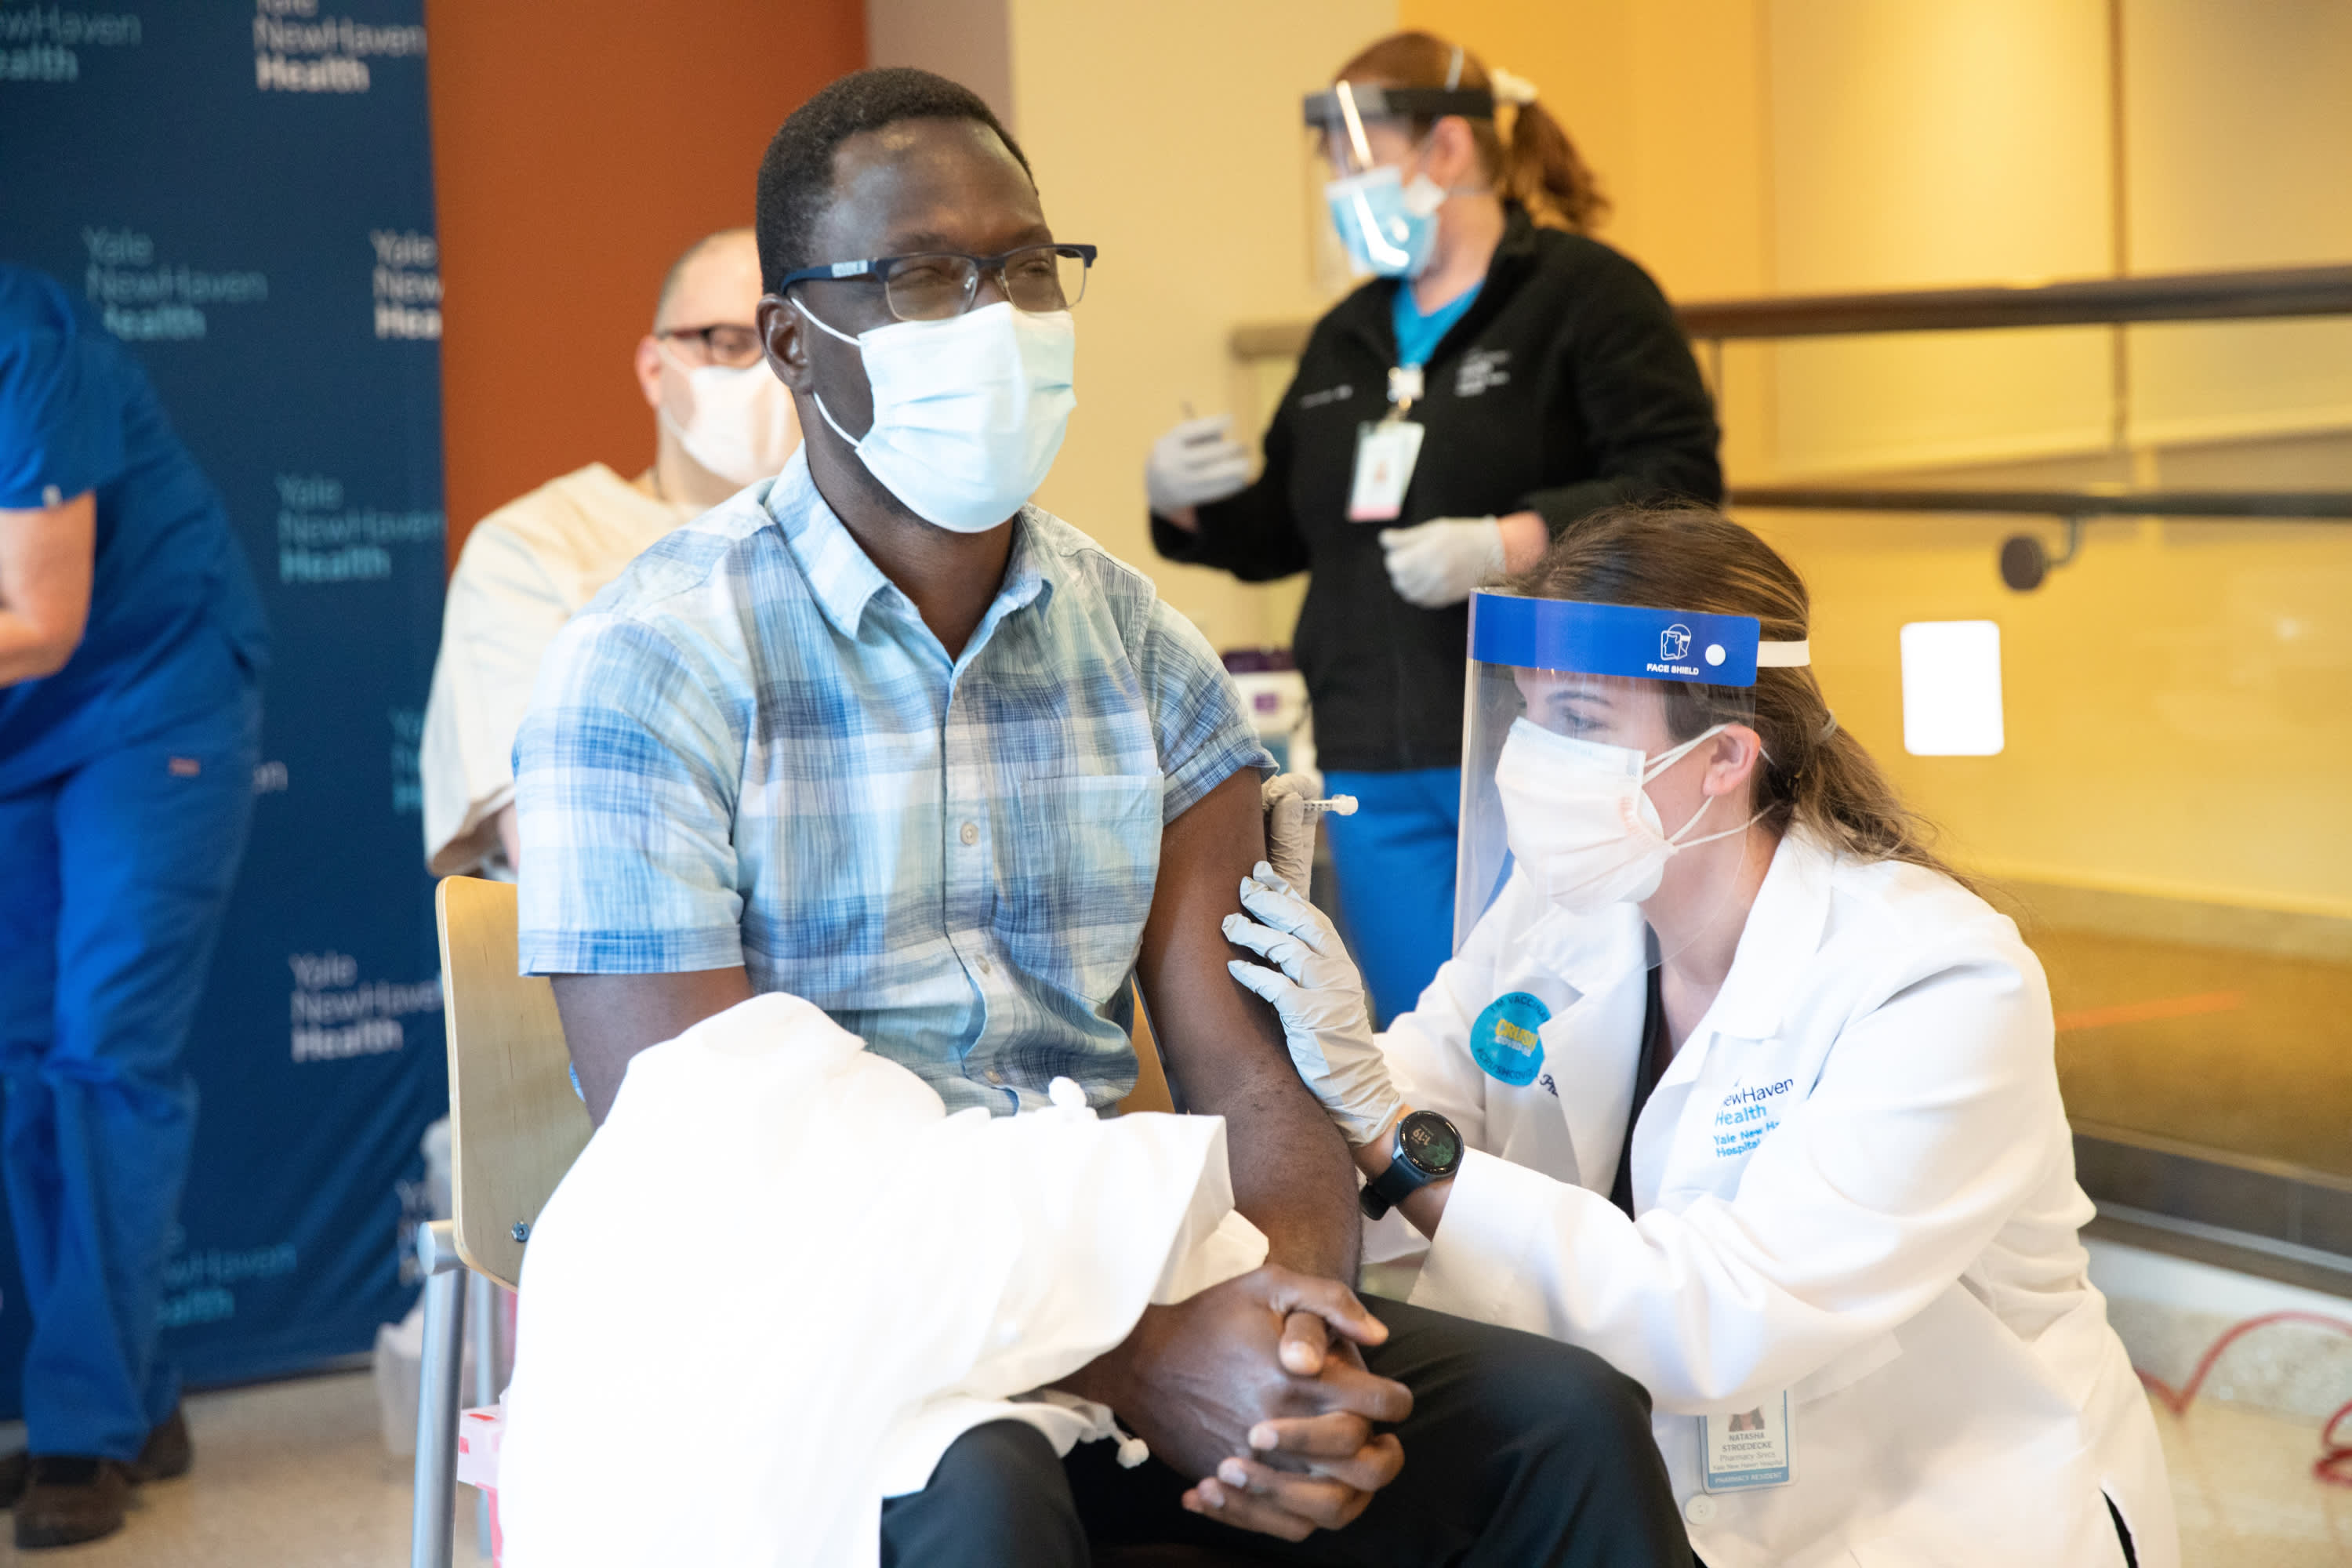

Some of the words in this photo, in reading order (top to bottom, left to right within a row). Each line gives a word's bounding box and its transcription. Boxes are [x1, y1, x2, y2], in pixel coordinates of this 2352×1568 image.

[253, 15, 427, 56] NewHaven
[256, 53, 370, 92] Health
[84, 227, 154, 266] Yale
[87, 264, 267, 303] NewHaven
[276, 473, 344, 509] Yale
[278, 509, 449, 546] NewHaven
[280, 545, 390, 583] Health
[1646, 663, 1669, 673] FACE
[1671, 665, 1699, 676] SHIELD
[289, 950, 358, 988] Yale
[291, 1021, 404, 1062] Health
[1715, 1104, 1767, 1127] Health
[1713, 1133, 1737, 1145] Yale
[1740, 1128, 1763, 1140] New
[1722, 1441, 1773, 1453] STROEDECKE
[1729, 1432, 1765, 1443] NATASHA
[1719, 1453, 1755, 1462] Pharmacy
